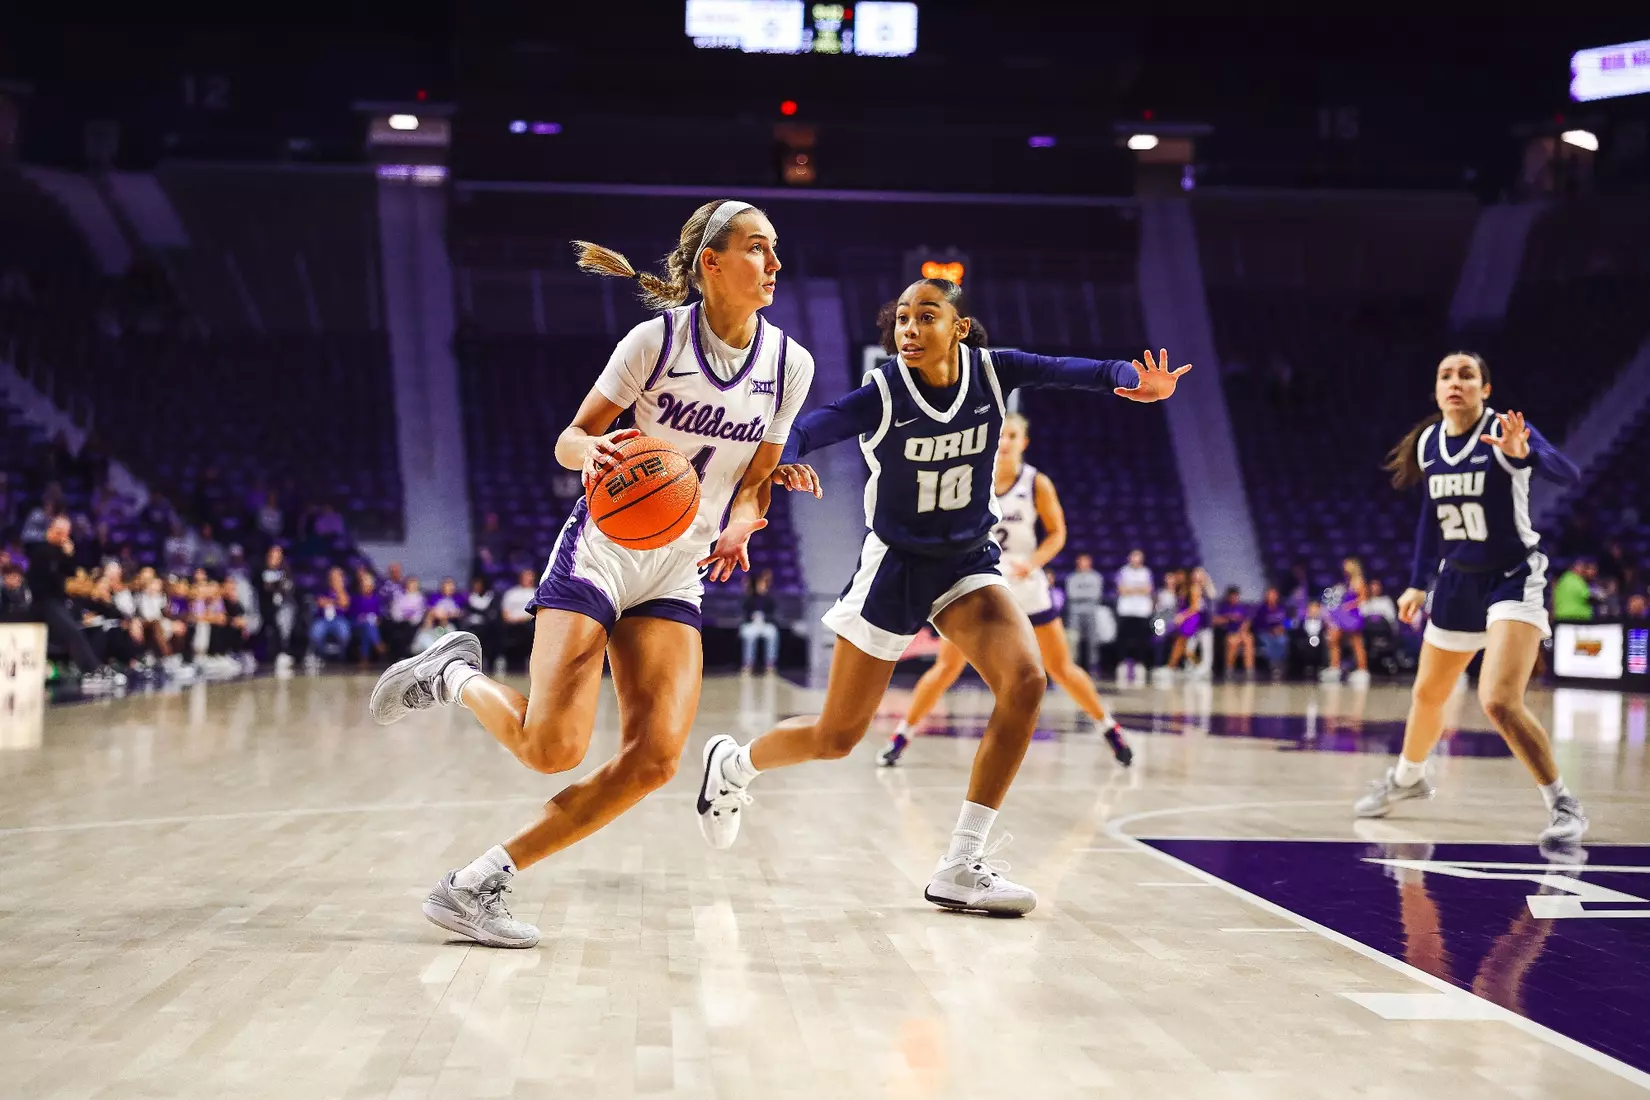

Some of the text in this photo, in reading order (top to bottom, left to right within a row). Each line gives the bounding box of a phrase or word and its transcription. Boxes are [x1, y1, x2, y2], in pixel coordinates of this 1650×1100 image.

[657, 392, 766, 443] Wildcats
[904, 422, 989, 462] ORU
[917, 464, 974, 513] 10
[1429, 471, 1486, 500] ORU
[1437, 502, 1488, 541] 20
